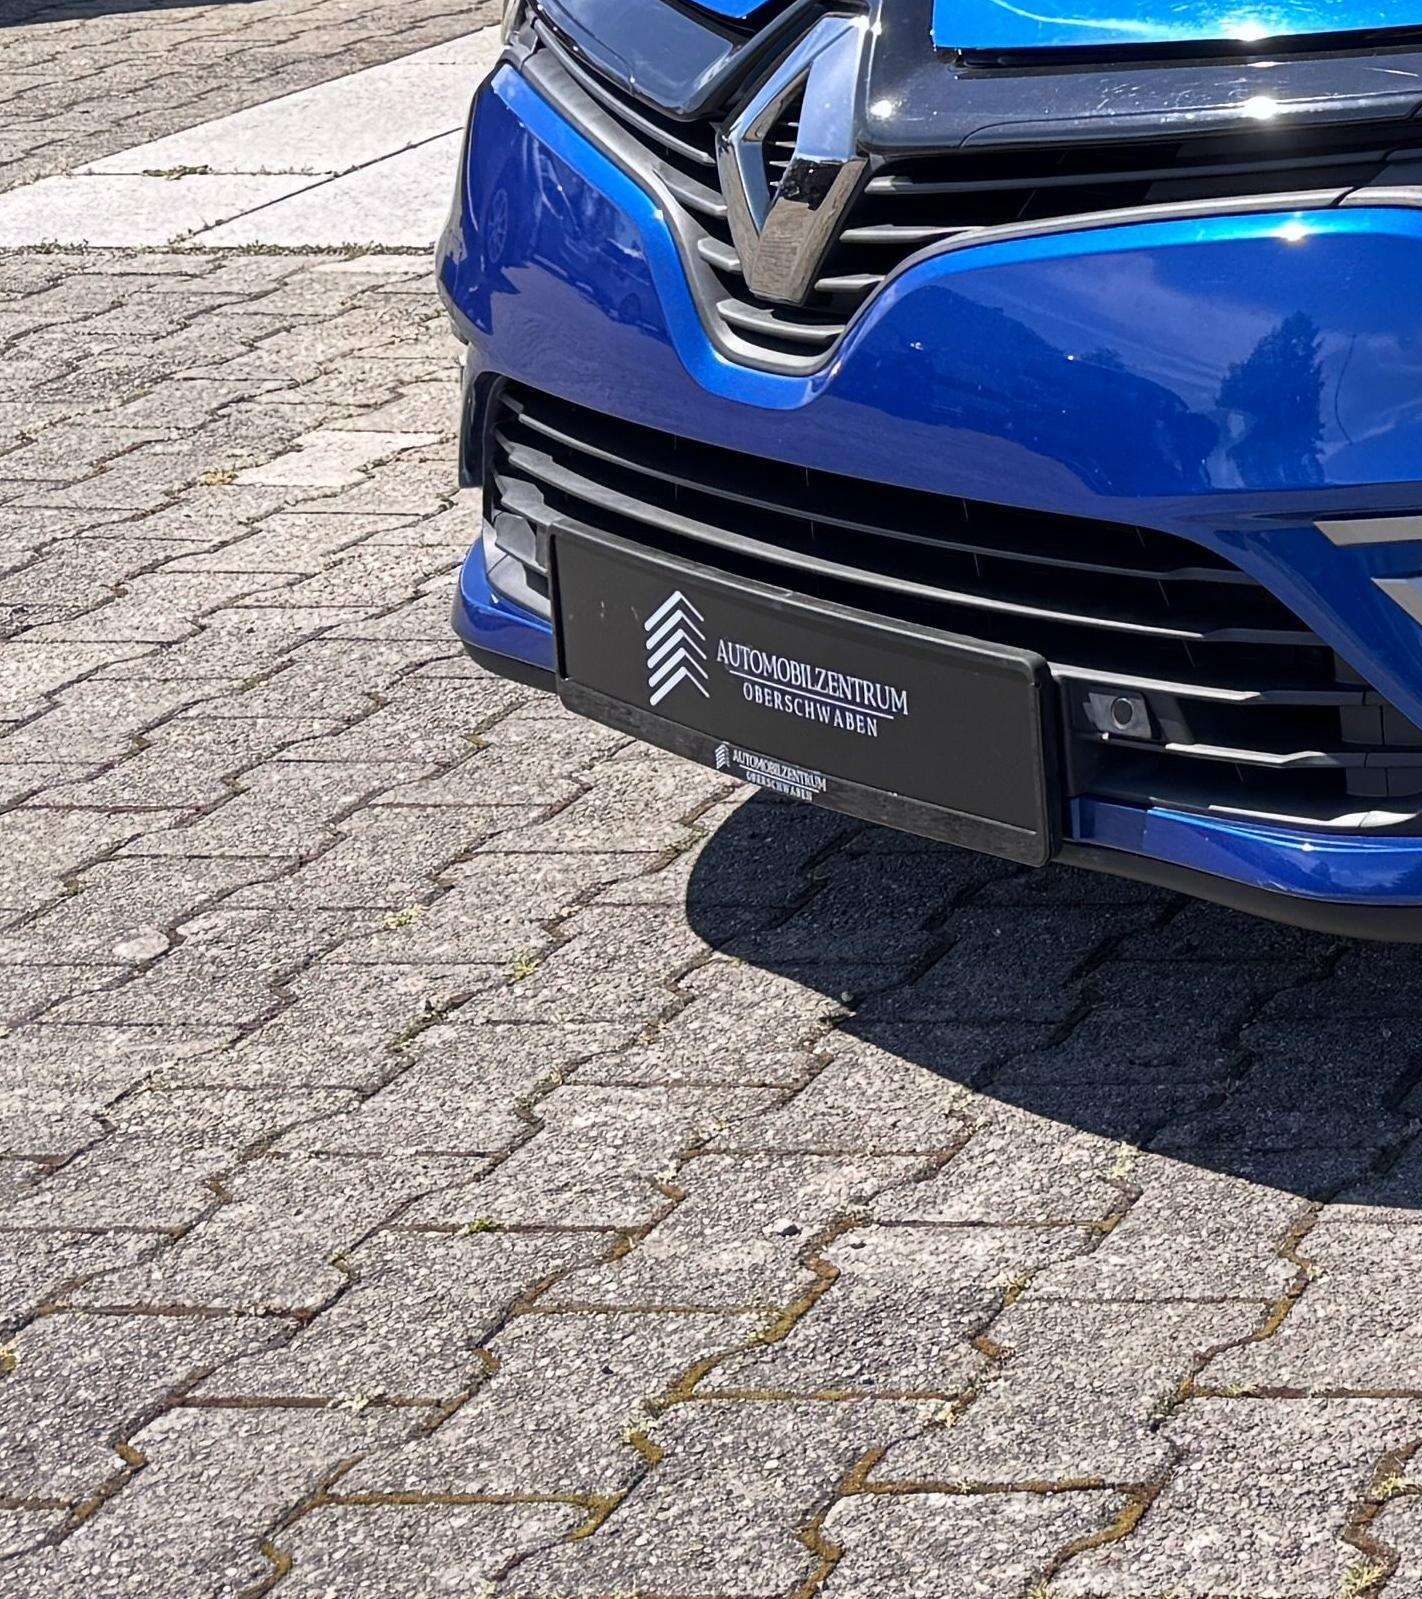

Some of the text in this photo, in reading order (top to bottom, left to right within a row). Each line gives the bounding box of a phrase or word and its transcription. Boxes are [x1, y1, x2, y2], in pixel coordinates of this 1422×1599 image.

[716, 638, 909, 716] AUTOMOBILZENTRUM
[742, 682, 878, 738] OBERSCHWABEN
[732, 749, 828, 793] AUTOMOBILZENTRUM
